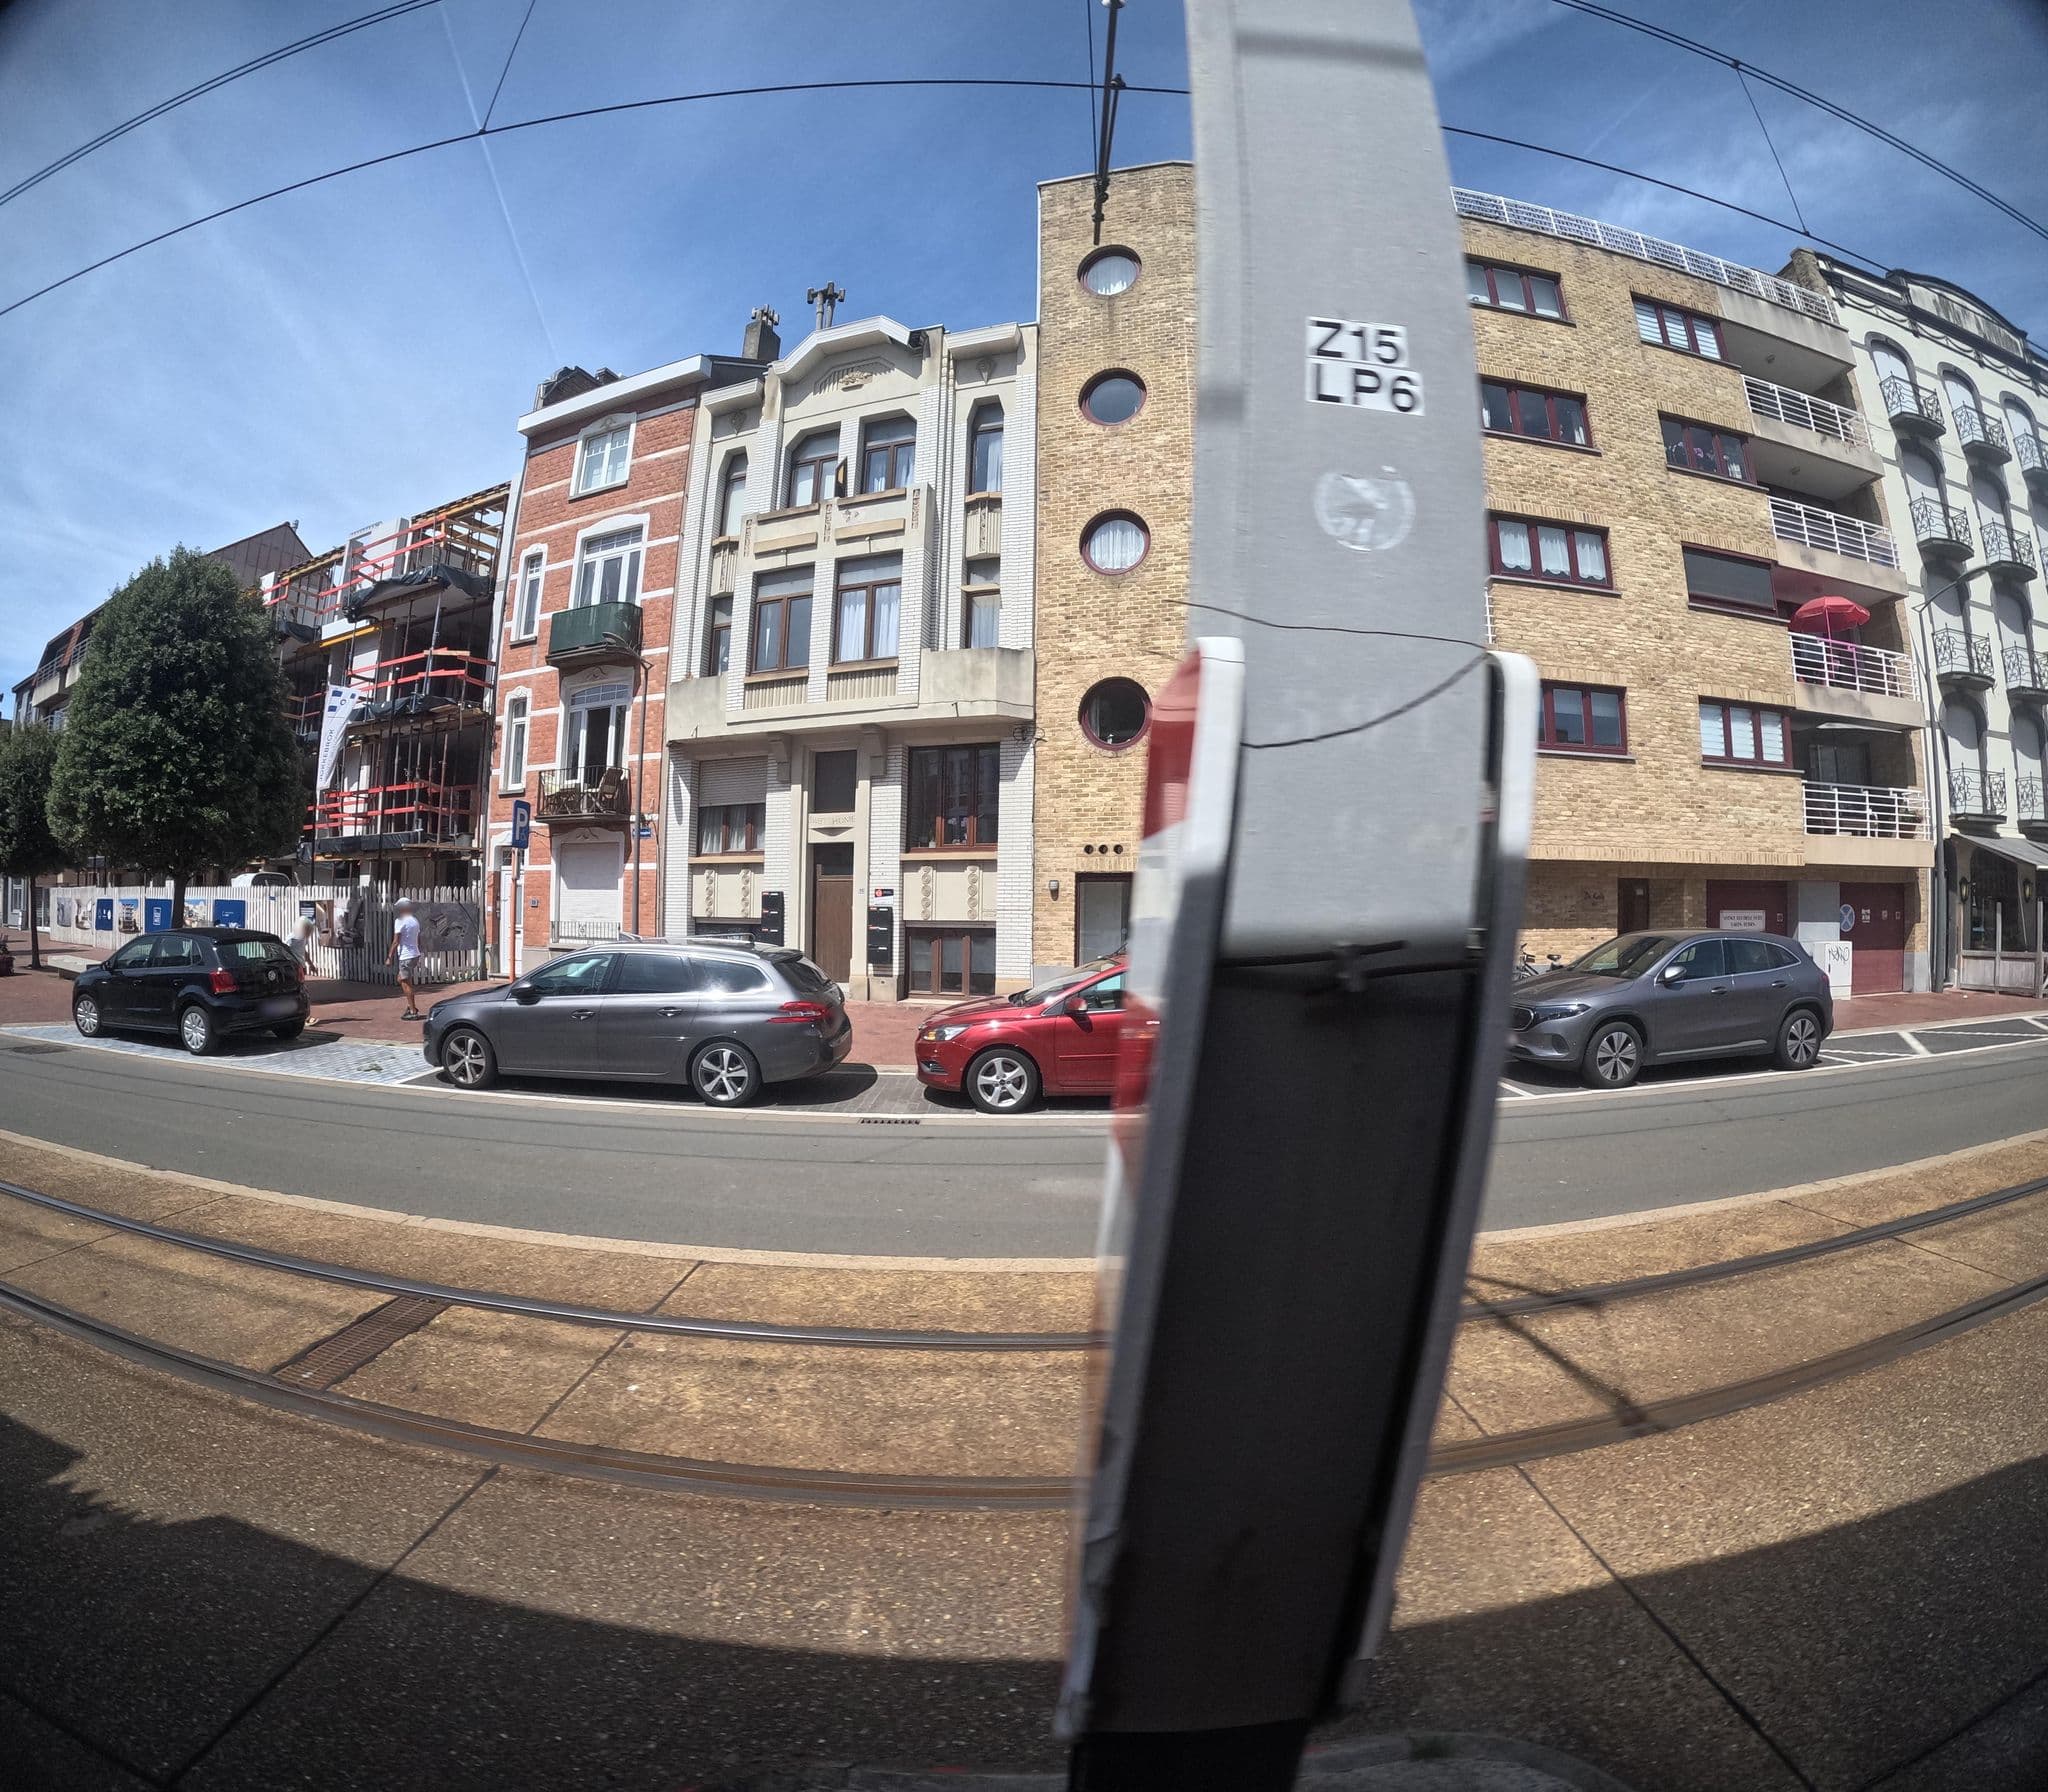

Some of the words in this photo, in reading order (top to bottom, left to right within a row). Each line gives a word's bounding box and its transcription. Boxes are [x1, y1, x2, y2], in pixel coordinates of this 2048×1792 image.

[1315, 320, 1399, 364] Z15
[1315, 363, 1416, 412] LP6
[515, 807, 528, 840] P
